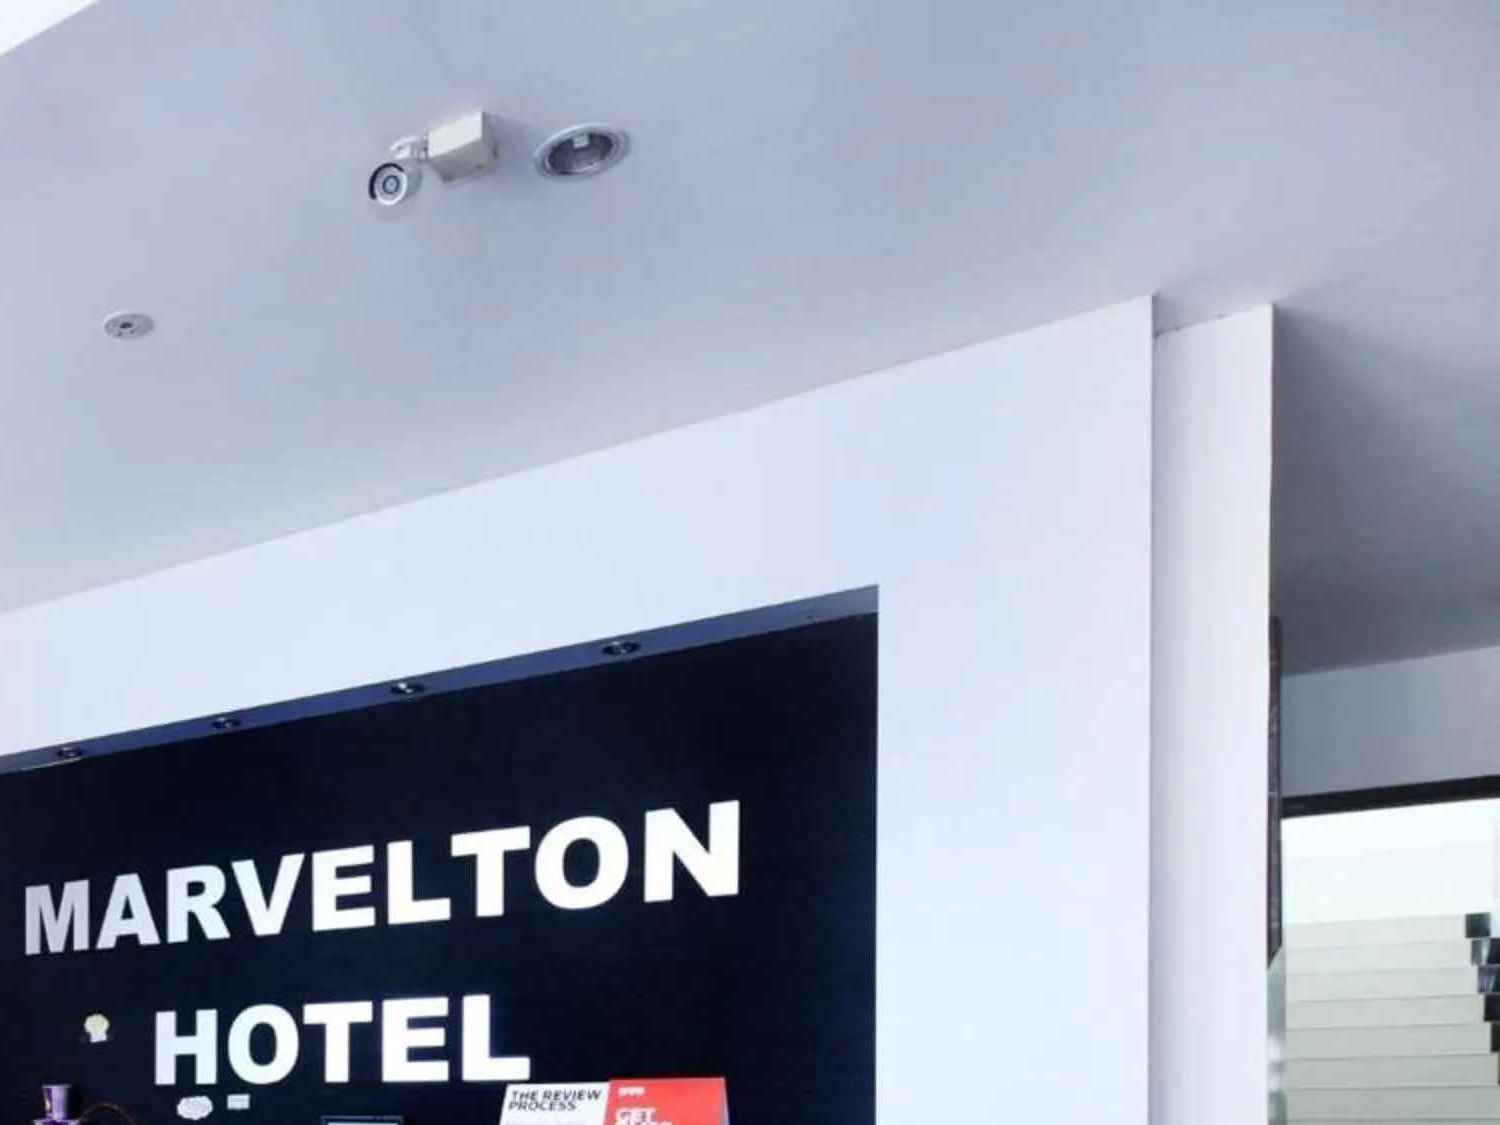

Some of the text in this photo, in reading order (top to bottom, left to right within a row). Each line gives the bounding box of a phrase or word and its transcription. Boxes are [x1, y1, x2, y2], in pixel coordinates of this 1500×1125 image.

[26, 800, 739, 954] MARVELTON
[155, 994, 530, 1085] HOTEL
[512, 1089, 602, 1101] THE REVIEW
[507, 1101, 577, 1112] PROCESS
[616, 1107, 656, 1122] GET
